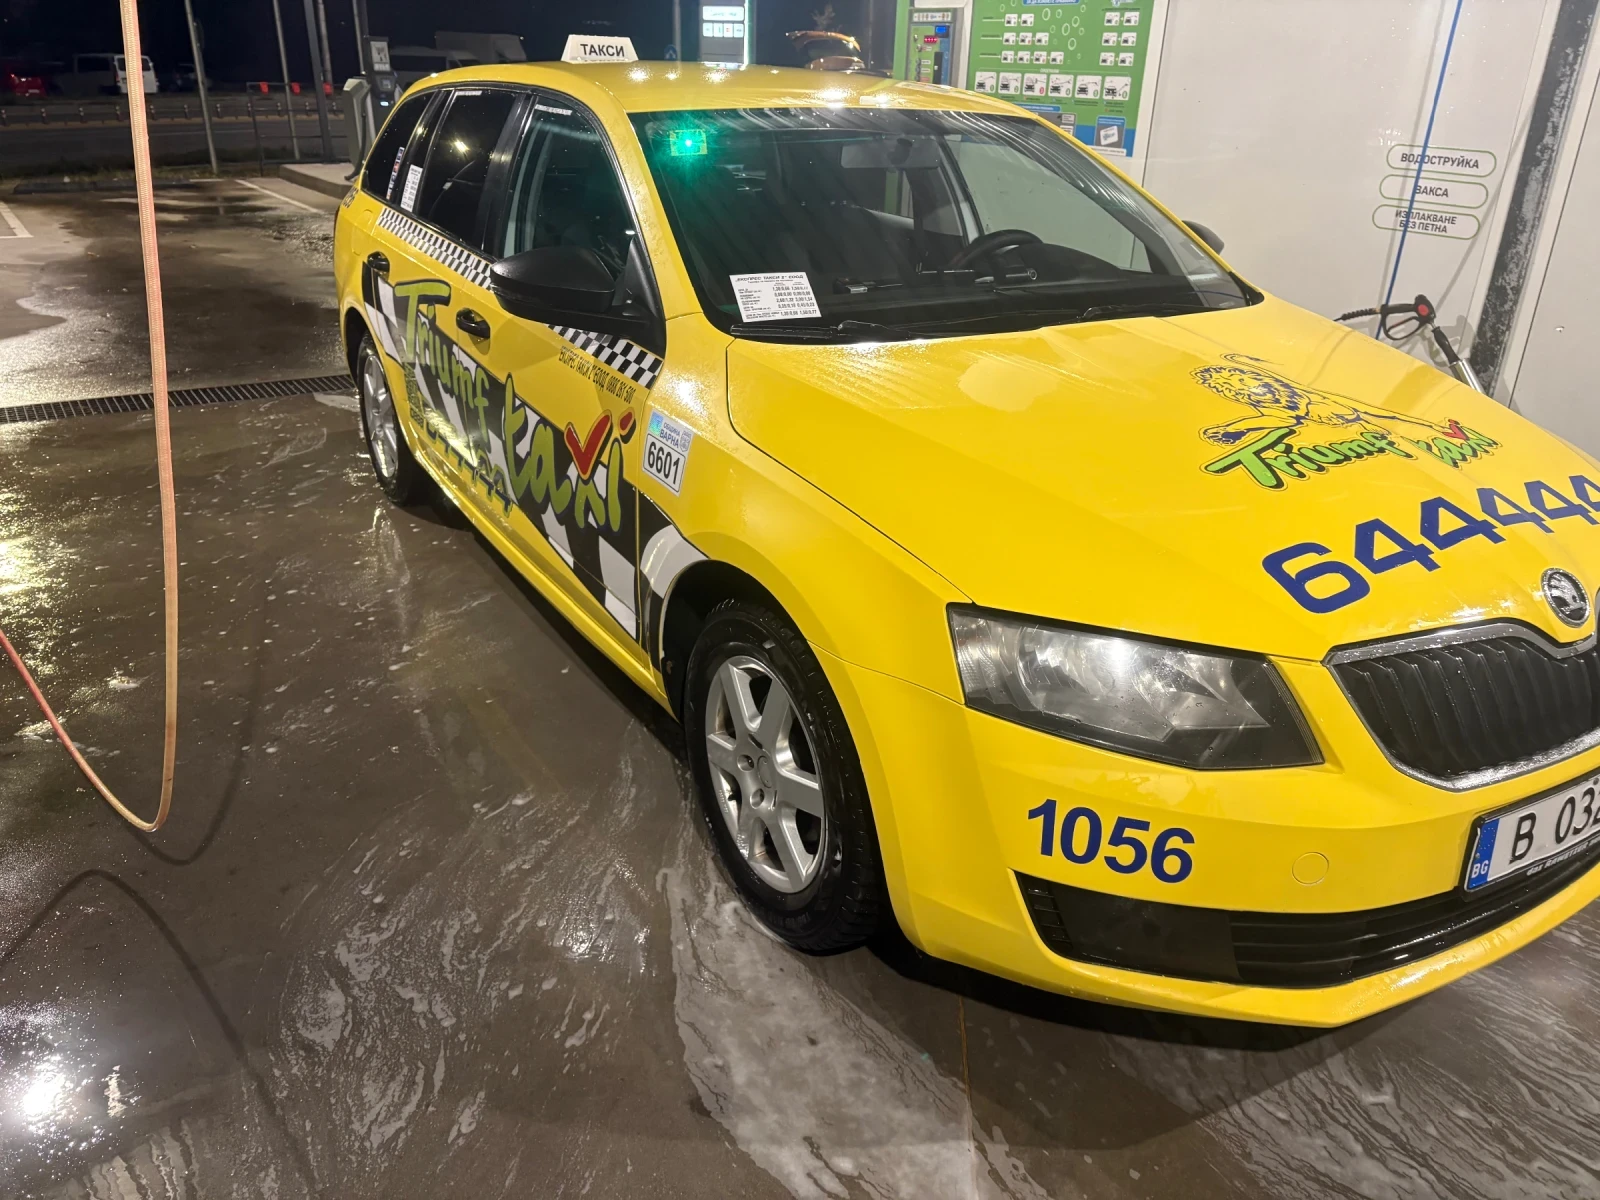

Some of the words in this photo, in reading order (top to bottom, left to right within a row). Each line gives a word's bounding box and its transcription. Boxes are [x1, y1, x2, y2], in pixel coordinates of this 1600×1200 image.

[580, 44, 624, 57] ТАКСИ
[1400, 153, 1479, 168] ВОДОСТРУЙКА
[1418, 222, 1447, 233] ПЕТНА
[393, 279, 490, 447] Triumf
[502, 372, 636, 533] taxi
[660, 429, 680, 447] ВАРНА
[648, 442, 680, 484] 6601
[1205, 427, 1414, 488] Triumf
[1028, 799, 1195, 883] 1056
[1509, 812, 1536, 864] B
[1471, 860, 1489, 878] BG
